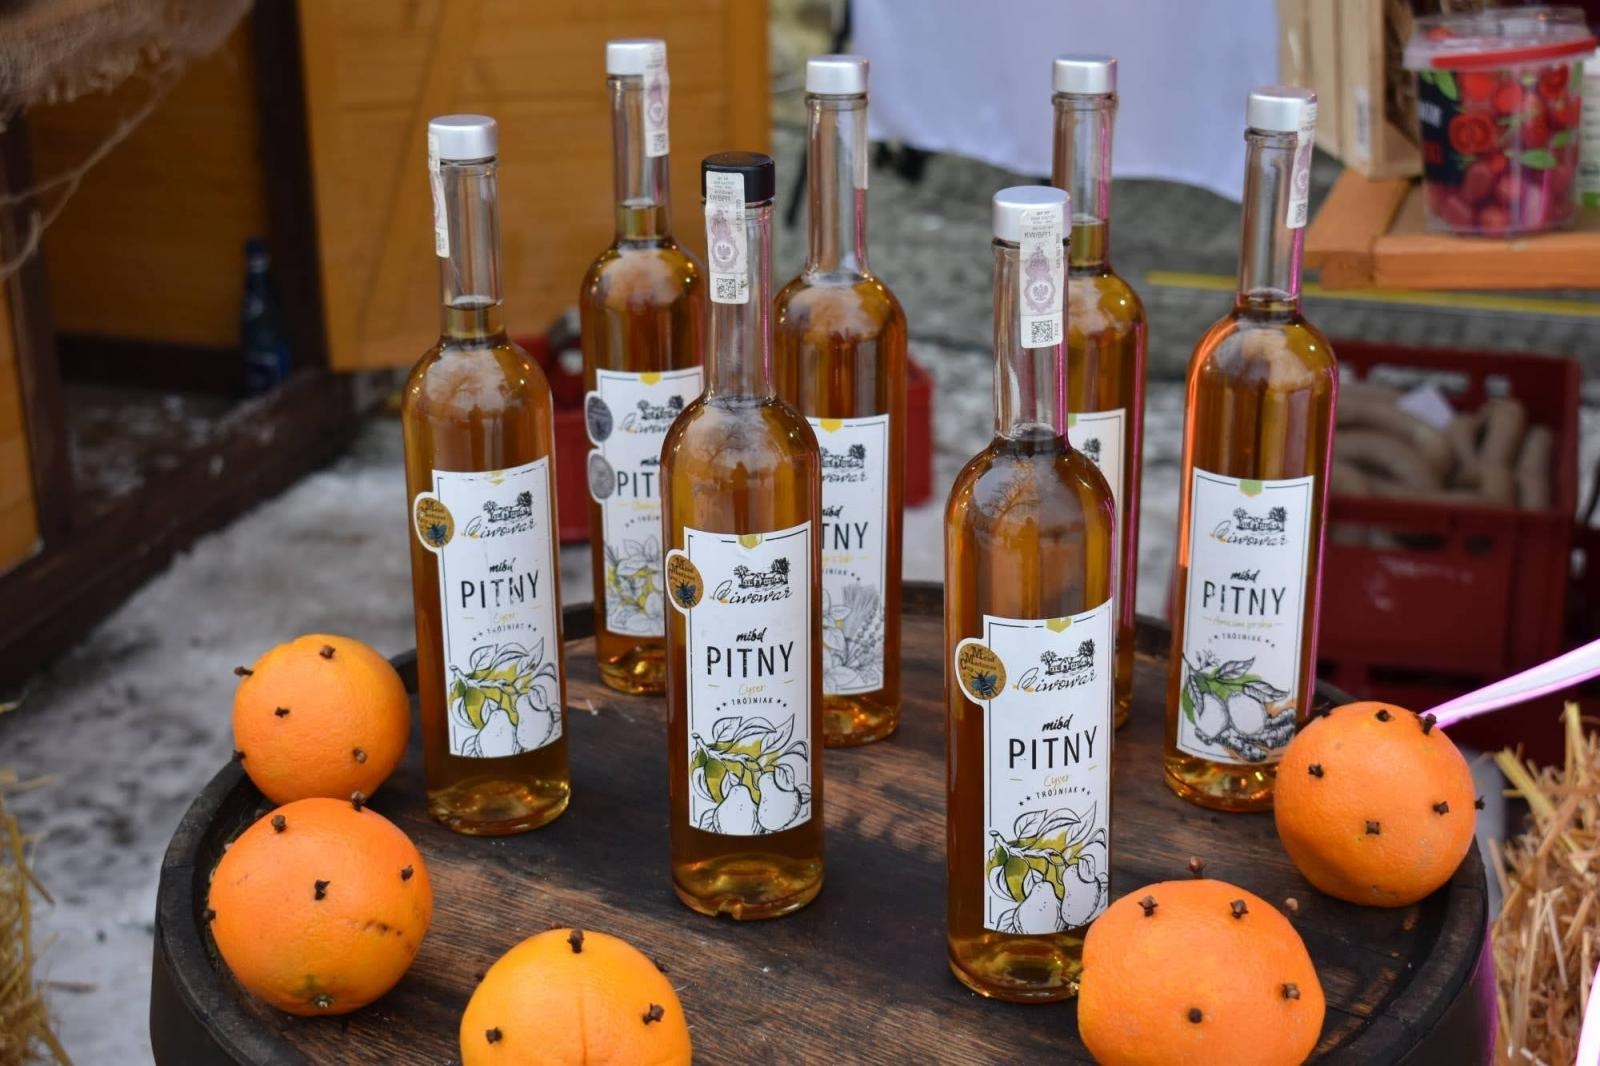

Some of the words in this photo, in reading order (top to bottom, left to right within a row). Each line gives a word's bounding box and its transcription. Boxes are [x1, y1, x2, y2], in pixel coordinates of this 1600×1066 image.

[616, 470, 654, 498] PIT
[821, 521, 868, 551] TNY
[461, 569, 539, 609] PITNY
[1202, 580, 1287, 616] PITNY
[735, 626, 768, 643] miód
[706, 640, 794, 679] PITNY
[1041, 712, 1074, 732] miód
[1008, 725, 1098, 771] PITNY
[1036, 785, 1079, 800] TRÓJNIAK
[1043, 773, 1071, 790] Cyser
